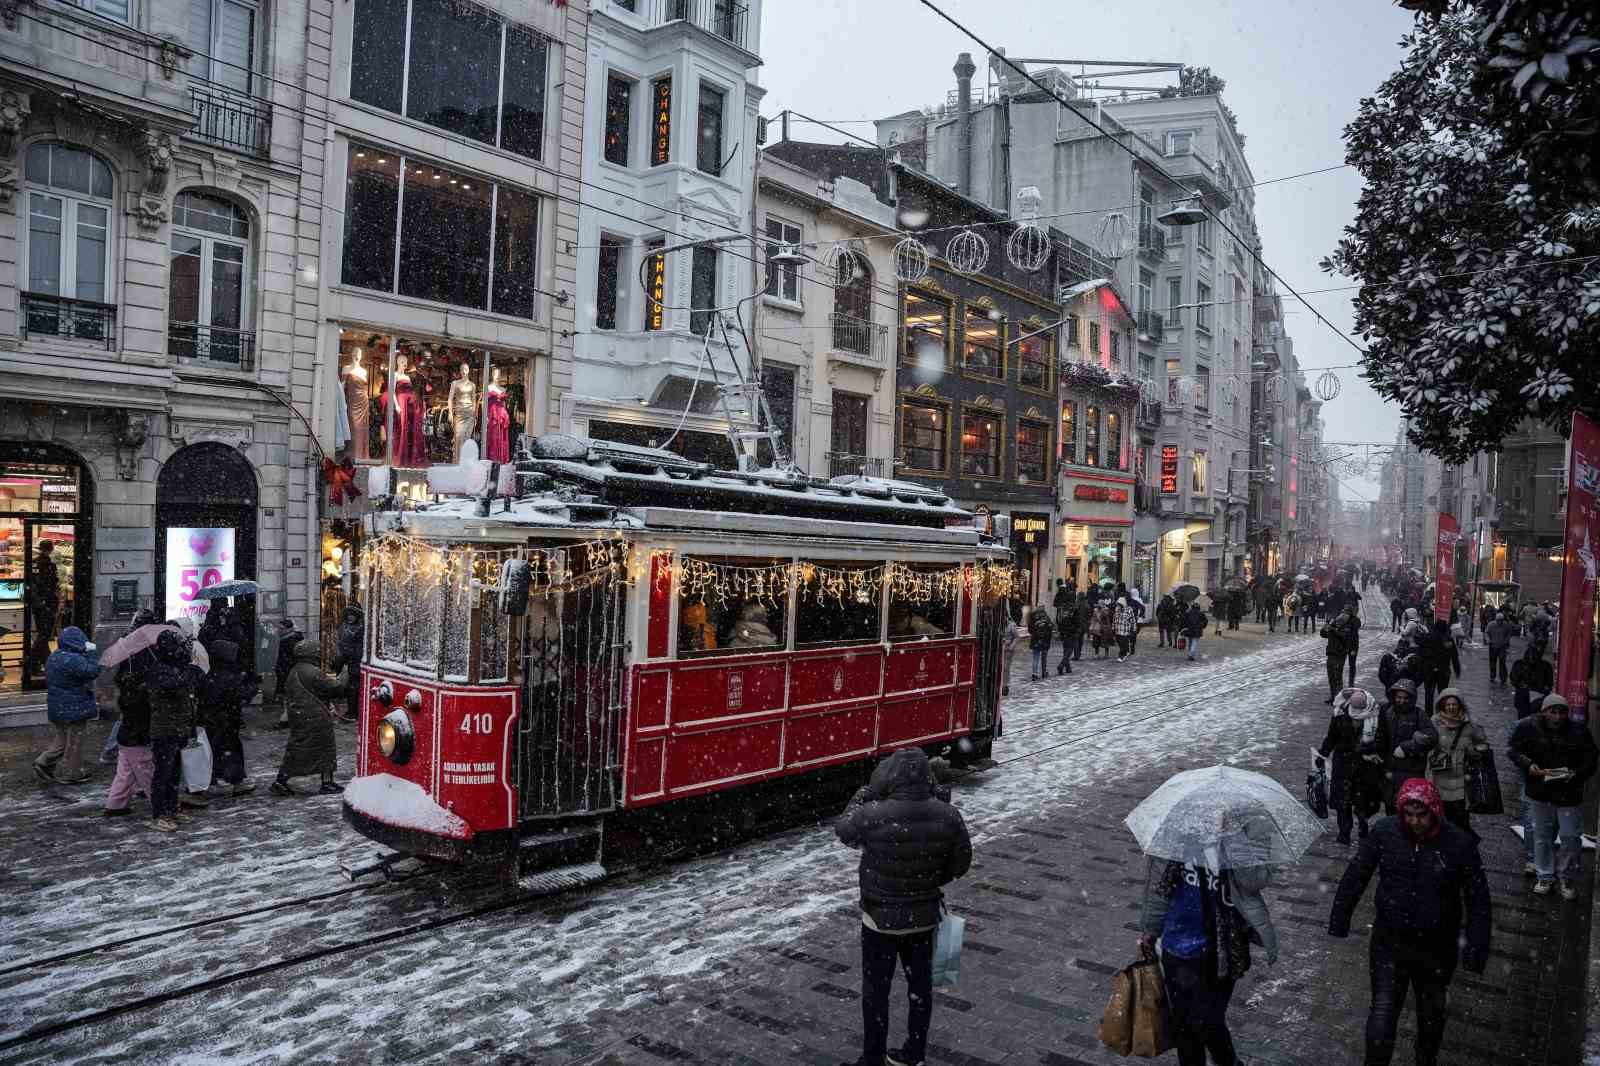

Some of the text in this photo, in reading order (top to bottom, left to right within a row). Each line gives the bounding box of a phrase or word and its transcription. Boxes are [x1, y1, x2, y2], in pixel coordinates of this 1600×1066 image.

[659, 85, 668, 160] CHANGE
[460, 712, 493, 735] 410
[473, 761, 496, 772] YASAK
